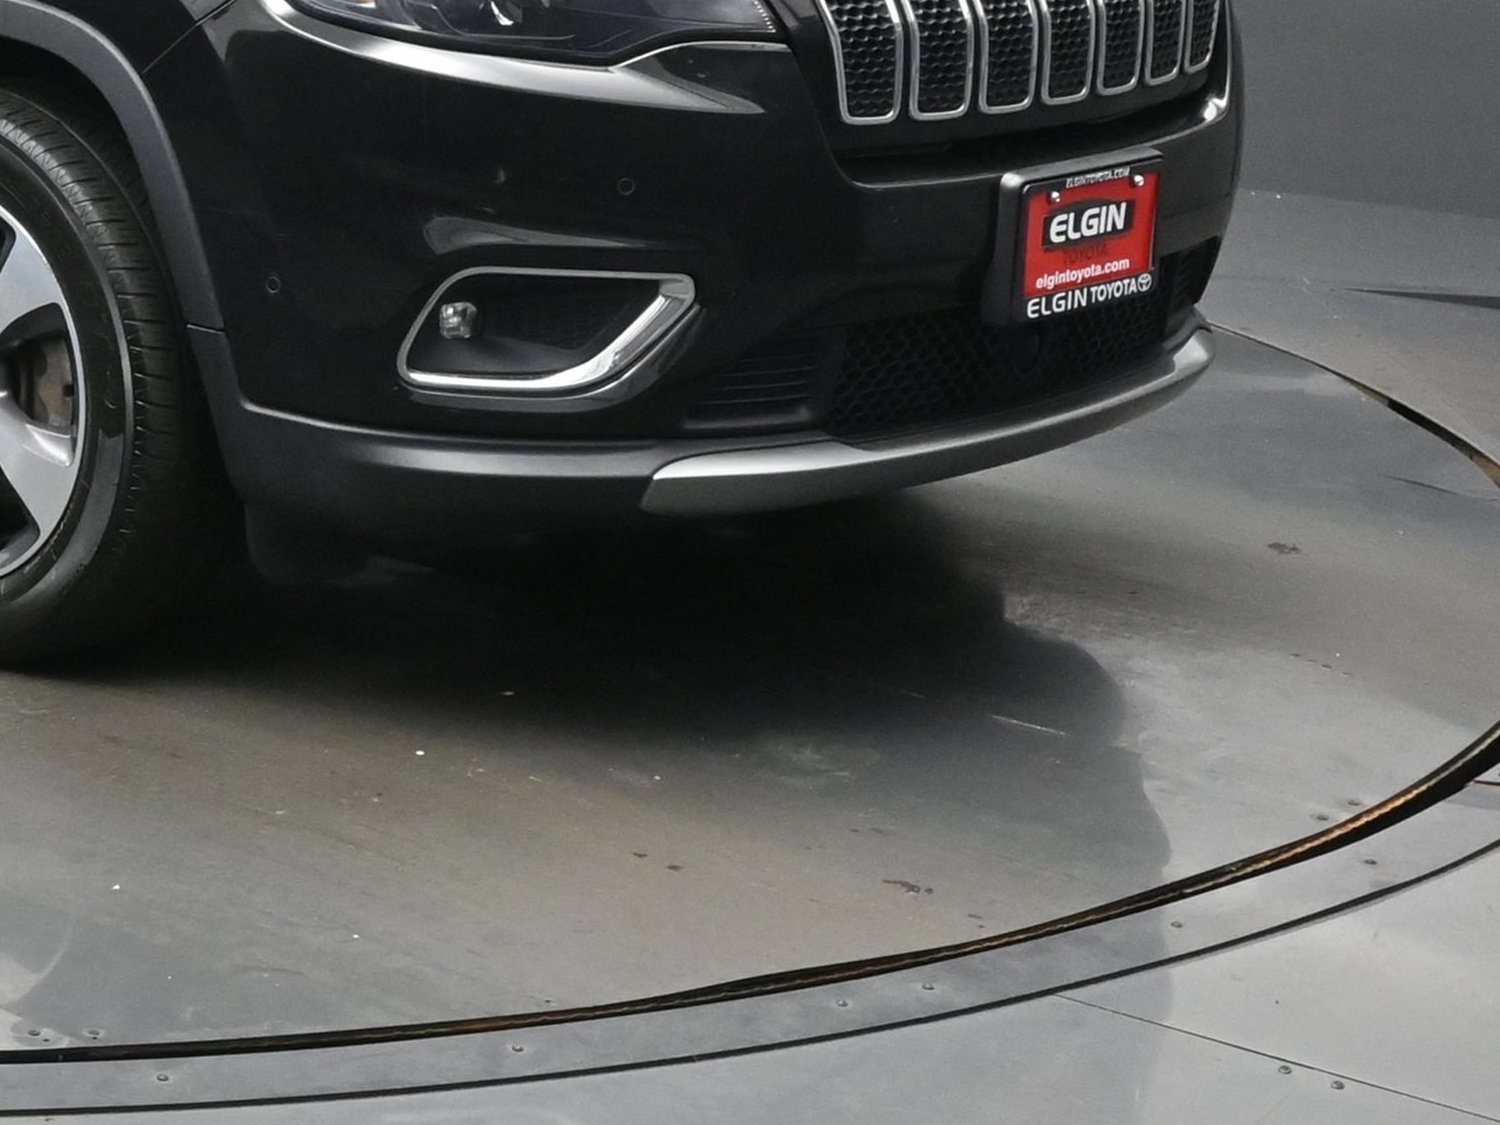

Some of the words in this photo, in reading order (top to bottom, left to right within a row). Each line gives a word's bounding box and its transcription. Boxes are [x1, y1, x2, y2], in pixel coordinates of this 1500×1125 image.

[1050, 202, 1127, 243] ELGIN
[1062, 243, 1109, 265] TOYOTA
[1035, 258, 1130, 290] elgintoyota.com
[1026, 286, 1088, 319] ELGIN
[1090, 277, 1138, 304] TOYOTA
